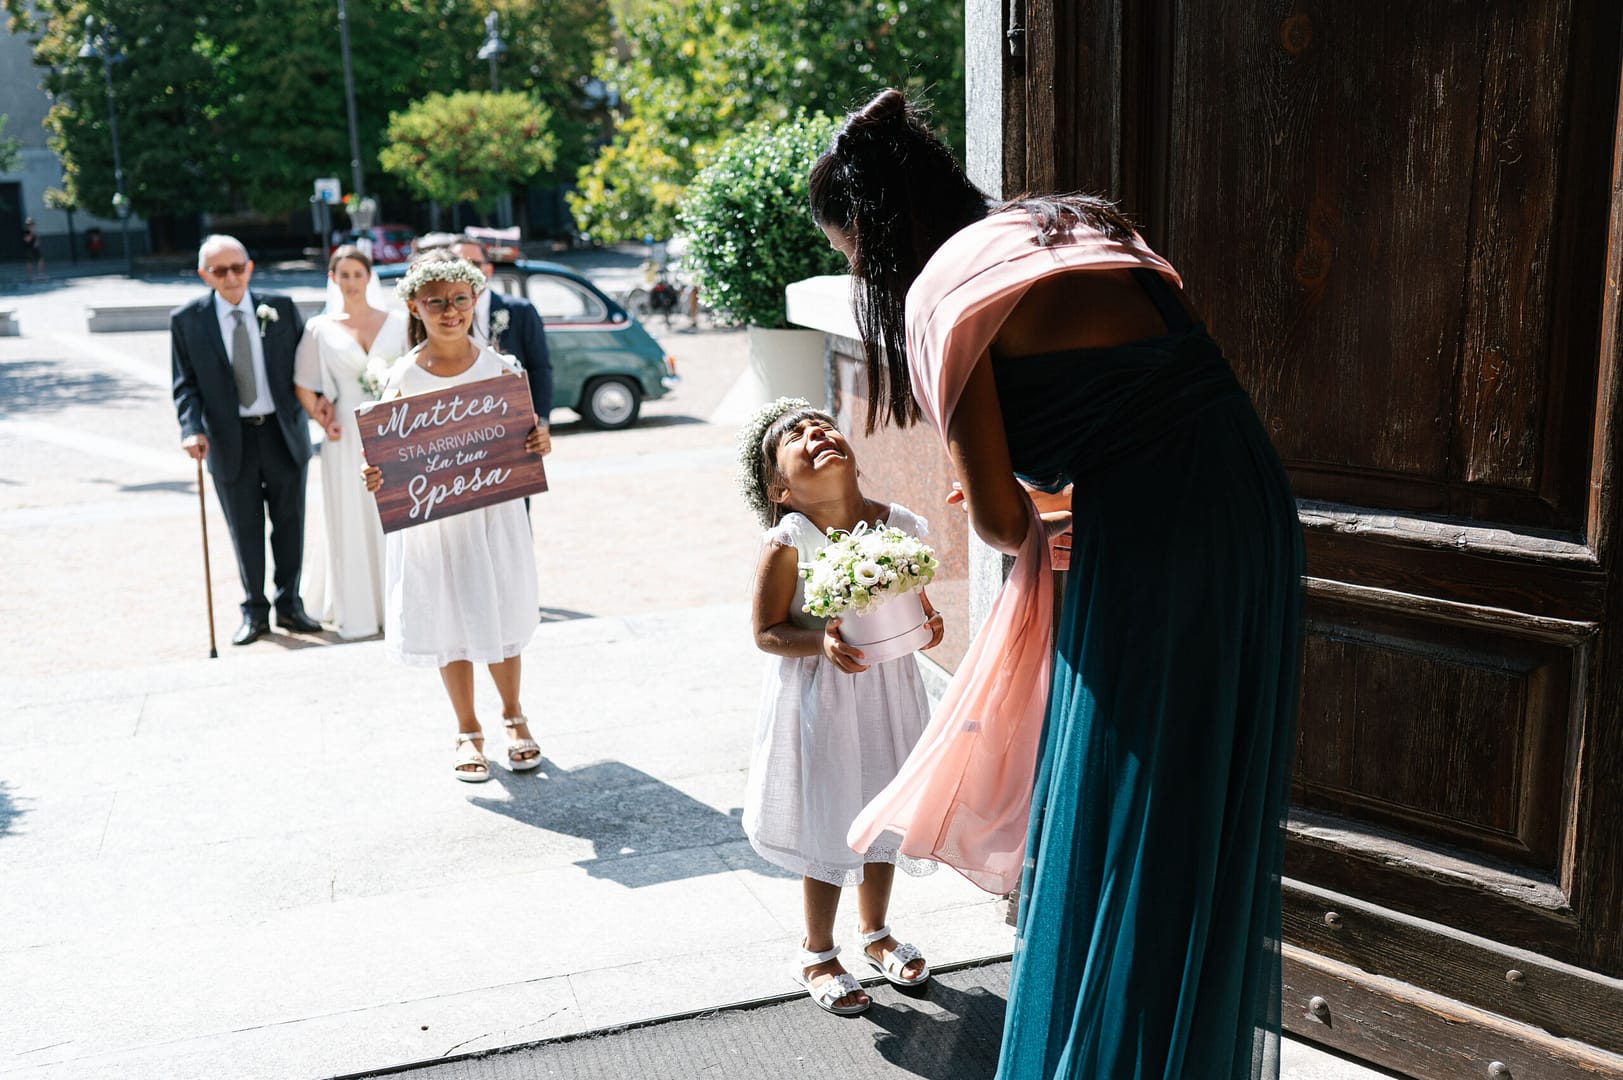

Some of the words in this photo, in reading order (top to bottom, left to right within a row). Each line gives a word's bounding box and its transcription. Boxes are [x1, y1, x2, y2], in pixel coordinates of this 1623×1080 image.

[378, 395, 508, 438] Matteo,
[398, 445, 426, 462] STA
[428, 424, 506, 455] ARRIVANDO
[425, 455, 453, 472] La
[456, 450, 488, 466] tua
[408, 467, 512, 520] Sposa
